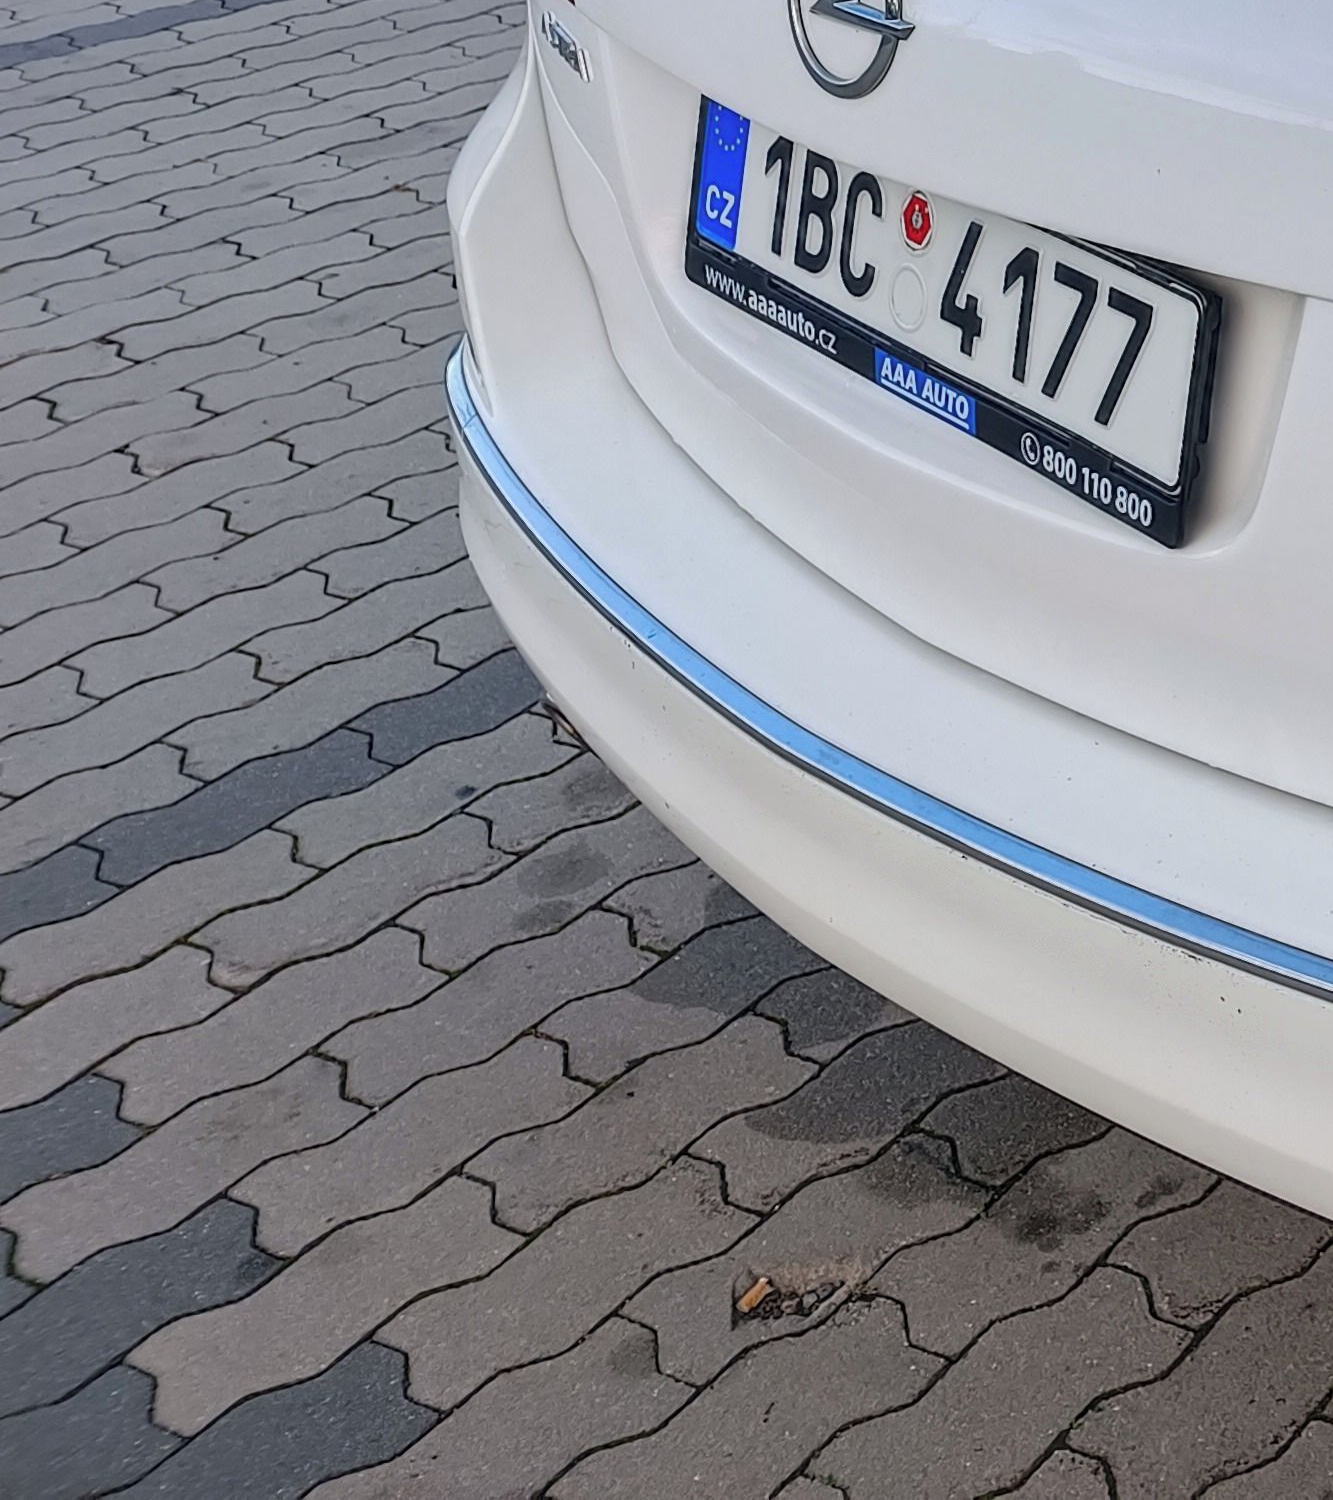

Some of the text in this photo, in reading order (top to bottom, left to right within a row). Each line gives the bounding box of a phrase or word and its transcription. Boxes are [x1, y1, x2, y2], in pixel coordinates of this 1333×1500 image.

[704, 183, 736, 229] CZ
[704, 263, 838, 355] www.aaaauto.cz
[763, 135, 1156, 427] 1BC 4177
[880, 357, 969, 420] AAA AUTO
[1042, 445, 1153, 527] 800 110 800
